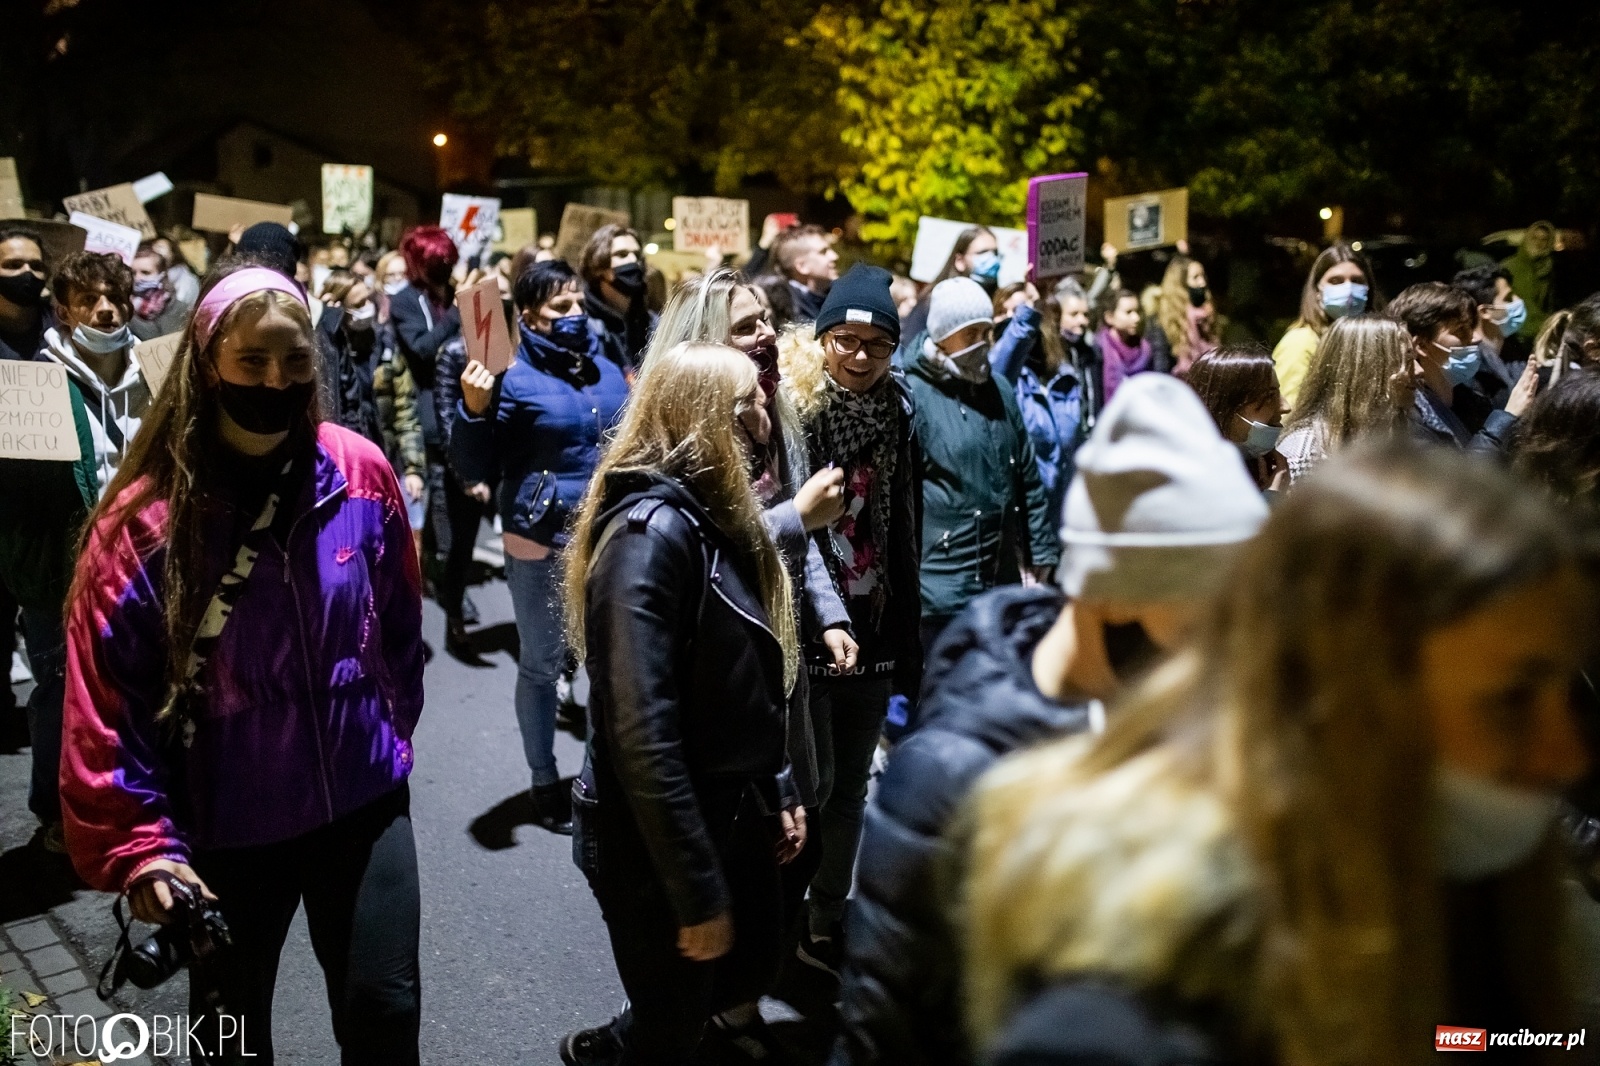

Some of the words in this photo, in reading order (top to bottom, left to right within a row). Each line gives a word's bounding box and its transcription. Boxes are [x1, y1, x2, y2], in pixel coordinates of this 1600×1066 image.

[1, 364, 28, 386] NIE
[36, 366, 62, 389] DO
[2, 431, 58, 451] AKTU
